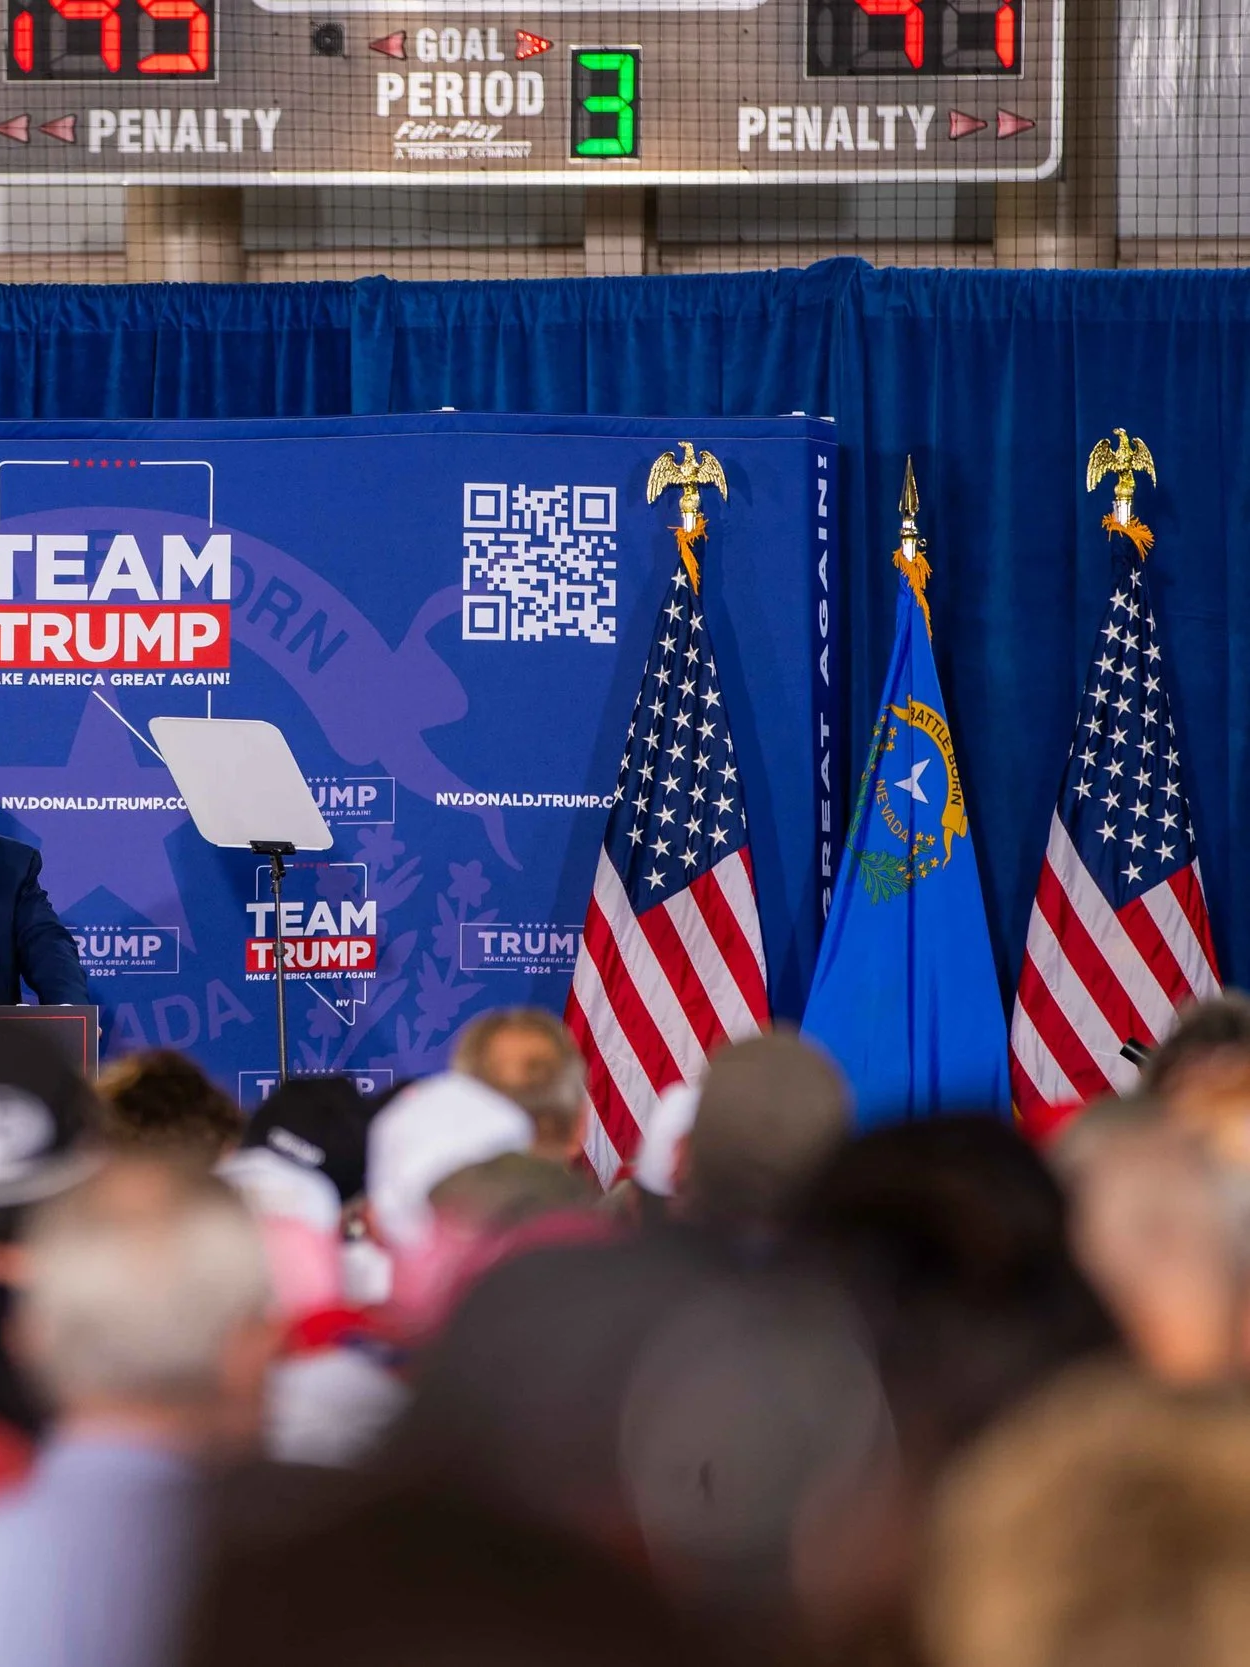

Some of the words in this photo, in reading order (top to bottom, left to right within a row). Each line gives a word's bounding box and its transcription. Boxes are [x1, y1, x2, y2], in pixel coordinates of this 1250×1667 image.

[416, 27, 504, 63] GOAL
[377, 70, 545, 117] PERIOD
[576, 53, 635, 156] 3
[88, 108, 282, 153] PENALTY
[737, 105, 935, 151] PENALTY
[817, 454, 829, 687] AGAIN!
[28, 673, 105, 686] AMERICA
[110, 673, 166, 686] GREAT
[171, 672, 230, 686] AGAIN!
[1, 796, 187, 811] NV.DONALDJTRUMP.CO
[310, 785, 378, 808] UMP
[436, 792, 612, 809] NV.DONALDJTRUMP.C
[875, 778, 909, 844] NEVADA
[346, 809, 371, 817] AGAIN!
[246, 901, 377, 938] TEAM
[74, 935, 162, 957] RUMP
[251, 940, 371, 969] TRUMP
[314, 972, 342, 980] GREAT
[345, 971, 376, 979] AGAIN!
[524, 966, 551, 974] 2024
